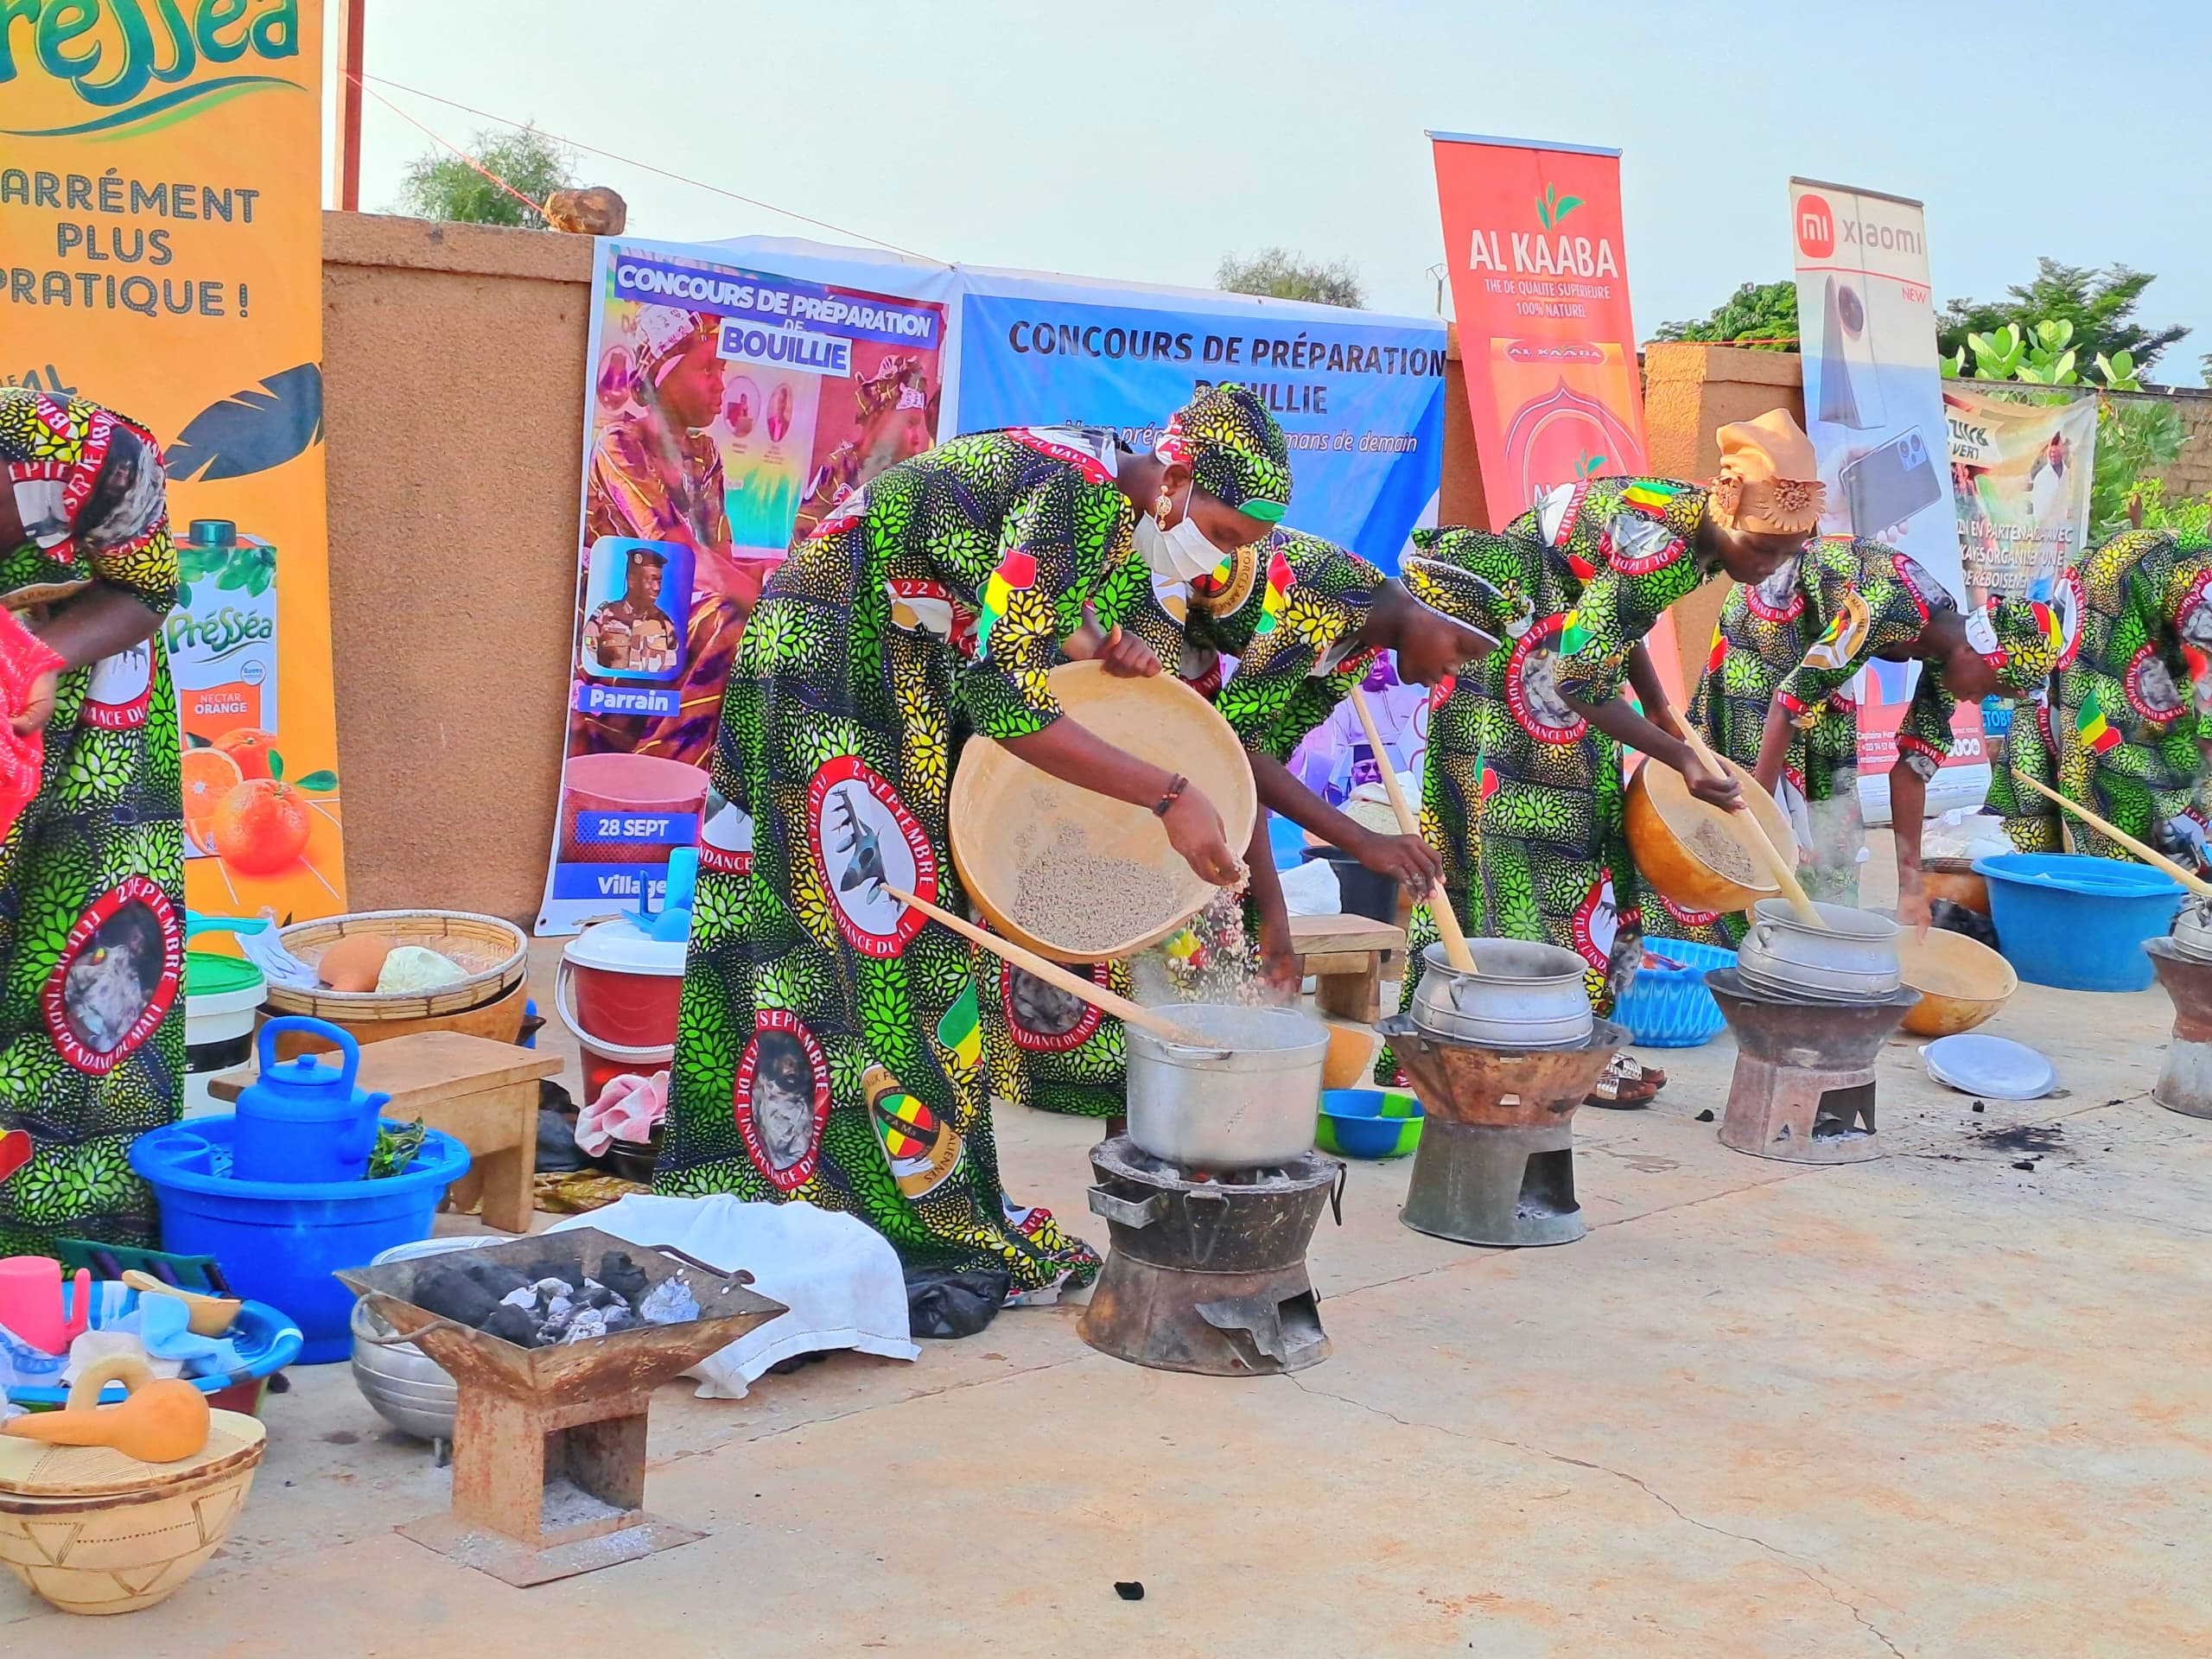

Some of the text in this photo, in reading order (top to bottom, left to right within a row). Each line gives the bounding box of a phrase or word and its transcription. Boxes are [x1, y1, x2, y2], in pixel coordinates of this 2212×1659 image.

[57, 222, 173, 265] PLUS
[1841, 219, 1923, 256] xiaomi
[1469, 228, 1619, 279] AL KAABA
[1503, 280, 1516, 295] DE
[1902, 287, 1927, 304] NEW
[238, 283, 249, 318] !
[616, 264, 932, 339] CONCOURS DE PRÉPARATION
[1516, 301, 1587, 319] 100% NATUREL
[783, 318, 805, 333] DE
[721, 326, 847, 371] BOUILLIE
[1008, 321, 1446, 378] CONCOURS DE PRÉPARATION
[1195, 378, 1328, 414] ILLIE
[1333, 429, 1354, 451] de
[1357, 430, 1419, 454] demain
[1971, 520, 1985, 537] EN
[194, 702, 248, 715] ORANGE
[200, 693, 242, 703] NECTAR
[589, 690, 669, 712] Parrain
[598, 818, 670, 837] 28 SEPT
[759, 1009, 830, 1093] SEPTEMBRE
[737, 1077, 752, 1099] DE
